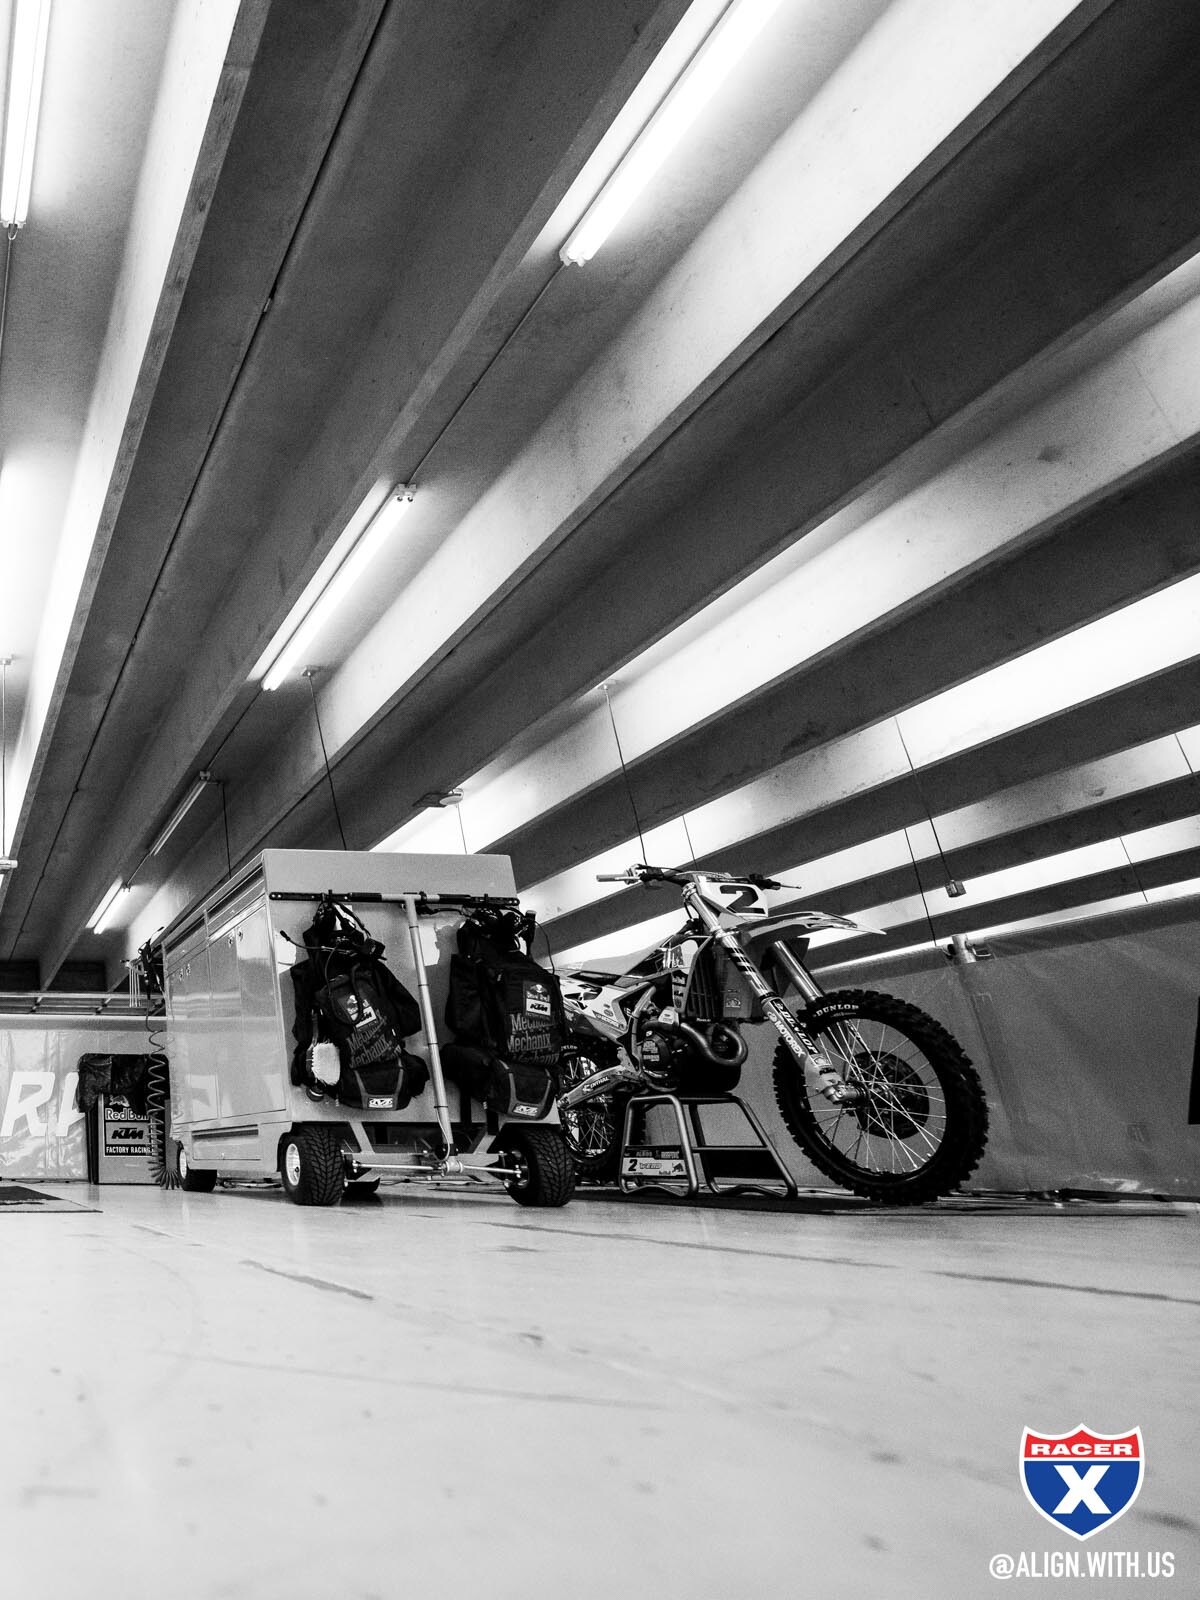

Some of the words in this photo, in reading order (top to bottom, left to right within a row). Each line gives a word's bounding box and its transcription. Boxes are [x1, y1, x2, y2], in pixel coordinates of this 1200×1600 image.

[719, 884, 766, 914] 2
[815, 1004, 860, 1016] DUNLOP
[779, 1009, 819, 1054] DULOP
[773, 1020, 807, 1058] MOTOREX
[105, 1108, 128, 1120] Red
[112, 1127, 144, 1139] KTM
[106, 1146, 129, 1154] FACTORY
[130, 1146, 151, 1154] RACING
[628, 1159, 638, 1171] 2
